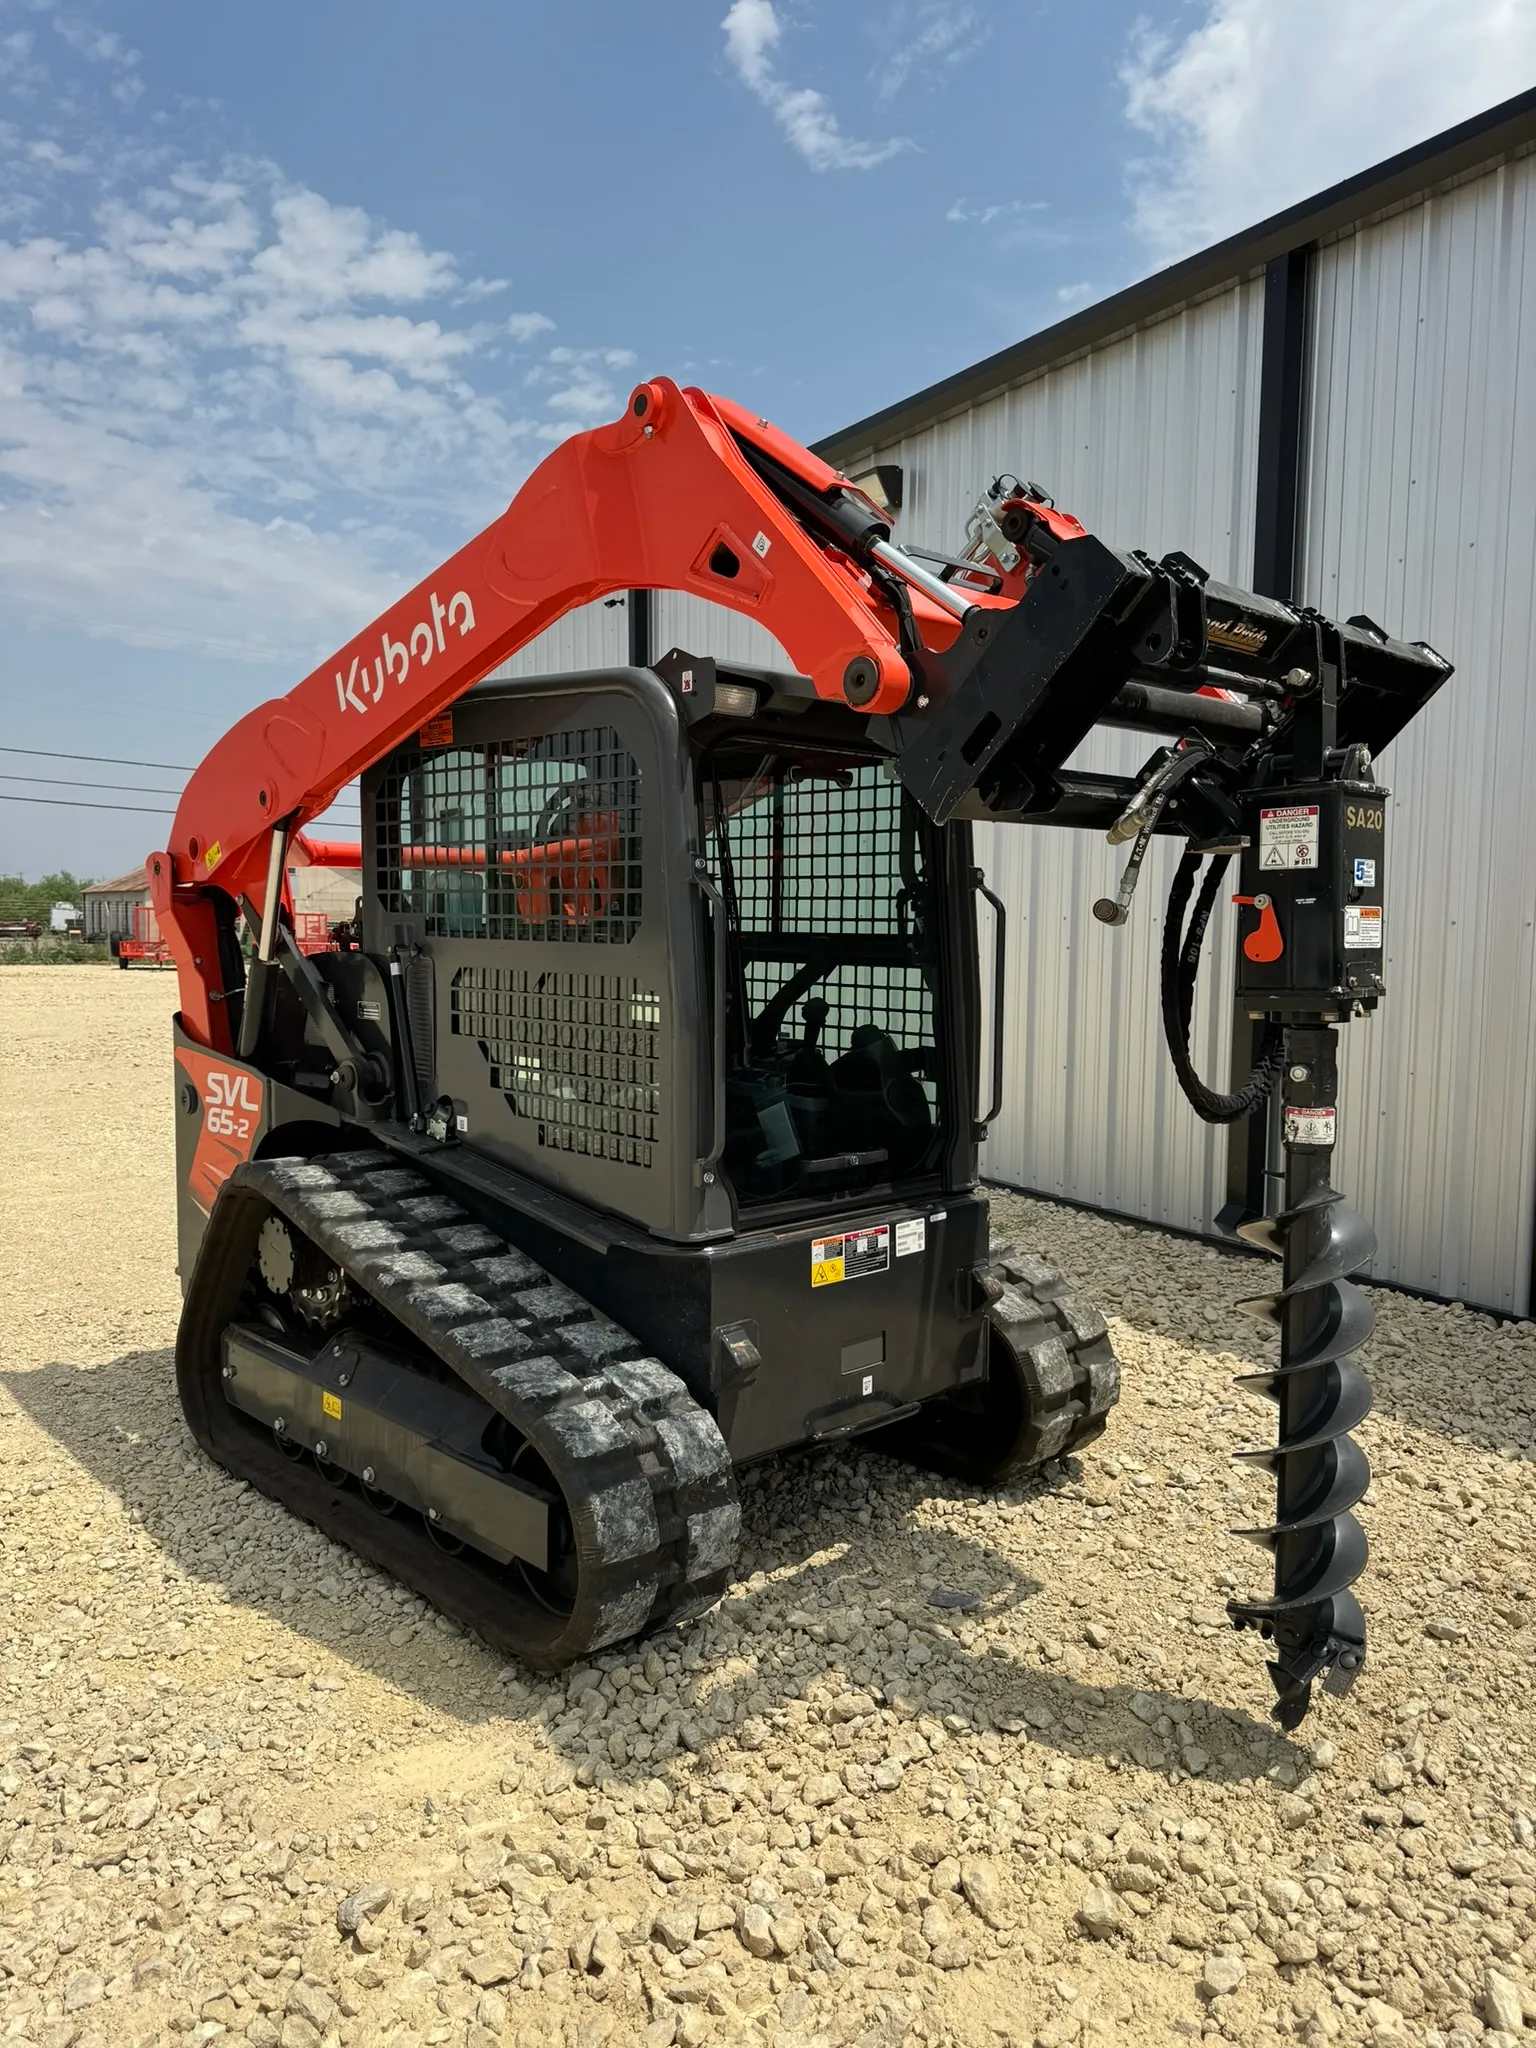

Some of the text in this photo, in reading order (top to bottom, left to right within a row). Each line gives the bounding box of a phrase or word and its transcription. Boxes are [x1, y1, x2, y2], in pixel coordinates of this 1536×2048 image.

[335, 591, 476, 714] Kubota
[1269, 816, 1311, 824] UNDERGROUND
[1276, 808, 1309, 817] DANGER
[1346, 805, 1383, 830] SA20
[205, 1072, 259, 1111] SVL
[207, 1107, 249, 1139] 65-2
